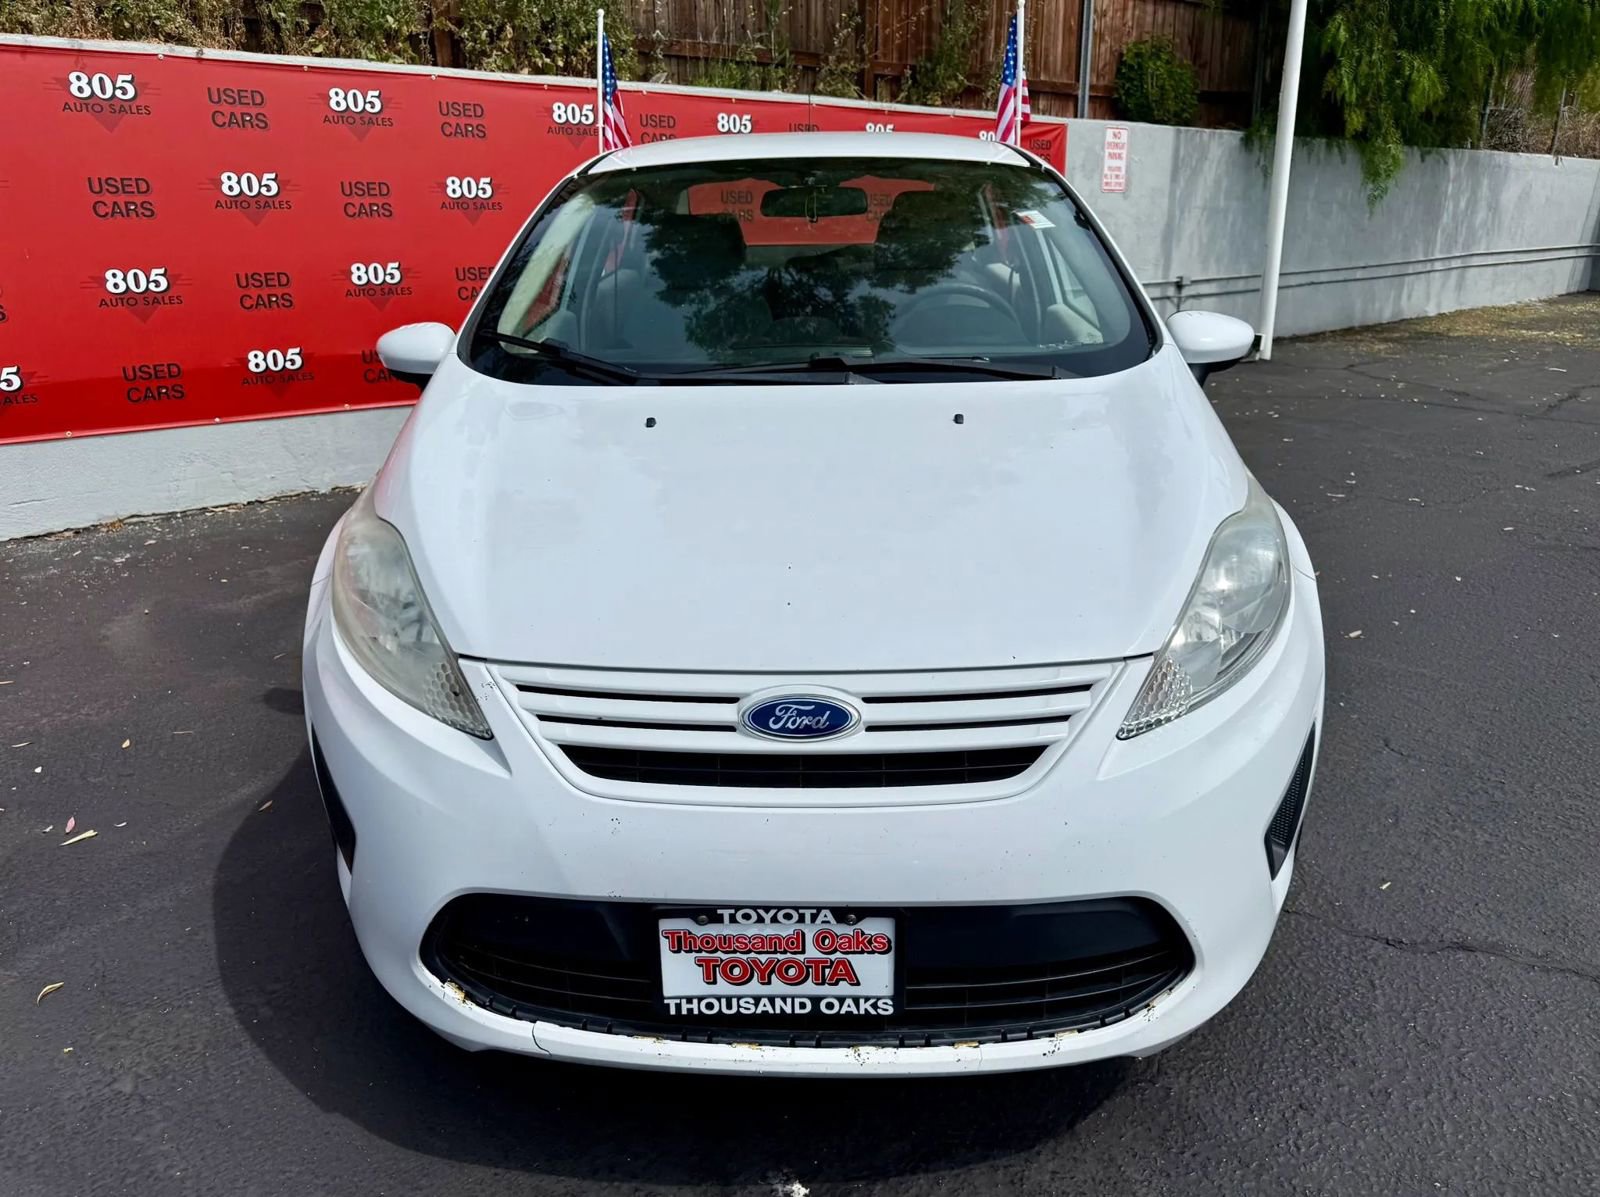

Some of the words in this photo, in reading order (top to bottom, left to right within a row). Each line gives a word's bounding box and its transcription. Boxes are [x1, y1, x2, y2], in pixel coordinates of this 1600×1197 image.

[68, 71, 137, 101] 805
[207, 87, 265, 107] USED
[328, 87, 383, 114] 805
[62, 102, 104, 114] AUTO
[109, 103, 152, 116] SALES
[438, 101, 484, 118] USED
[552, 101, 595, 126] 805
[211, 110, 269, 130] CARS
[323, 114, 356, 126] AUTO
[360, 115, 394, 127] SALES
[639, 113, 676, 129] USED
[717, 112, 753, 135] 805
[440, 122, 487, 139] CARS
[547, 126, 573, 136] AUTO
[576, 127, 599, 137] SALE
[87, 177, 151, 195] USED
[220, 171, 280, 198] 805
[340, 181, 390, 198] USED
[445, 176, 494, 200] 805
[214, 199, 250, 210] AUTO
[254, 199, 292, 211] SALES
[720, 189, 753, 205] USED
[92, 201, 155, 218] CARS
[343, 202, 393, 218] CARS
[440, 201, 470, 211] AUTO
[472, 202, 503, 212] SALES
[105, 267, 170, 294] 805
[236, 272, 291, 289] USED
[350, 262, 402, 286] 805
[98, 295, 138, 308] AUTO
[143, 295, 183, 307] SALES
[345, 287, 377, 299] AUTO
[380, 286, 413, 298] SALES
[239, 294, 294, 311] CARS
[247, 347, 304, 374] 805
[122, 363, 181, 382] USED
[241, 374, 276, 387] AUTO
[279, 372, 315, 383] SALES
[0, 393, 39, 406] ALES
[126, 384, 185, 403] CARS
[768, 703, 832, 730] Ford
[716, 908, 837, 926] TOYOTA
[661, 929, 806, 956] Thousand
[812, 928, 893, 955] Oaks
[694, 957, 861, 987] TOYOTA
[663, 997, 813, 1016] THOUSAND
[819, 997, 895, 1016] OAKS
